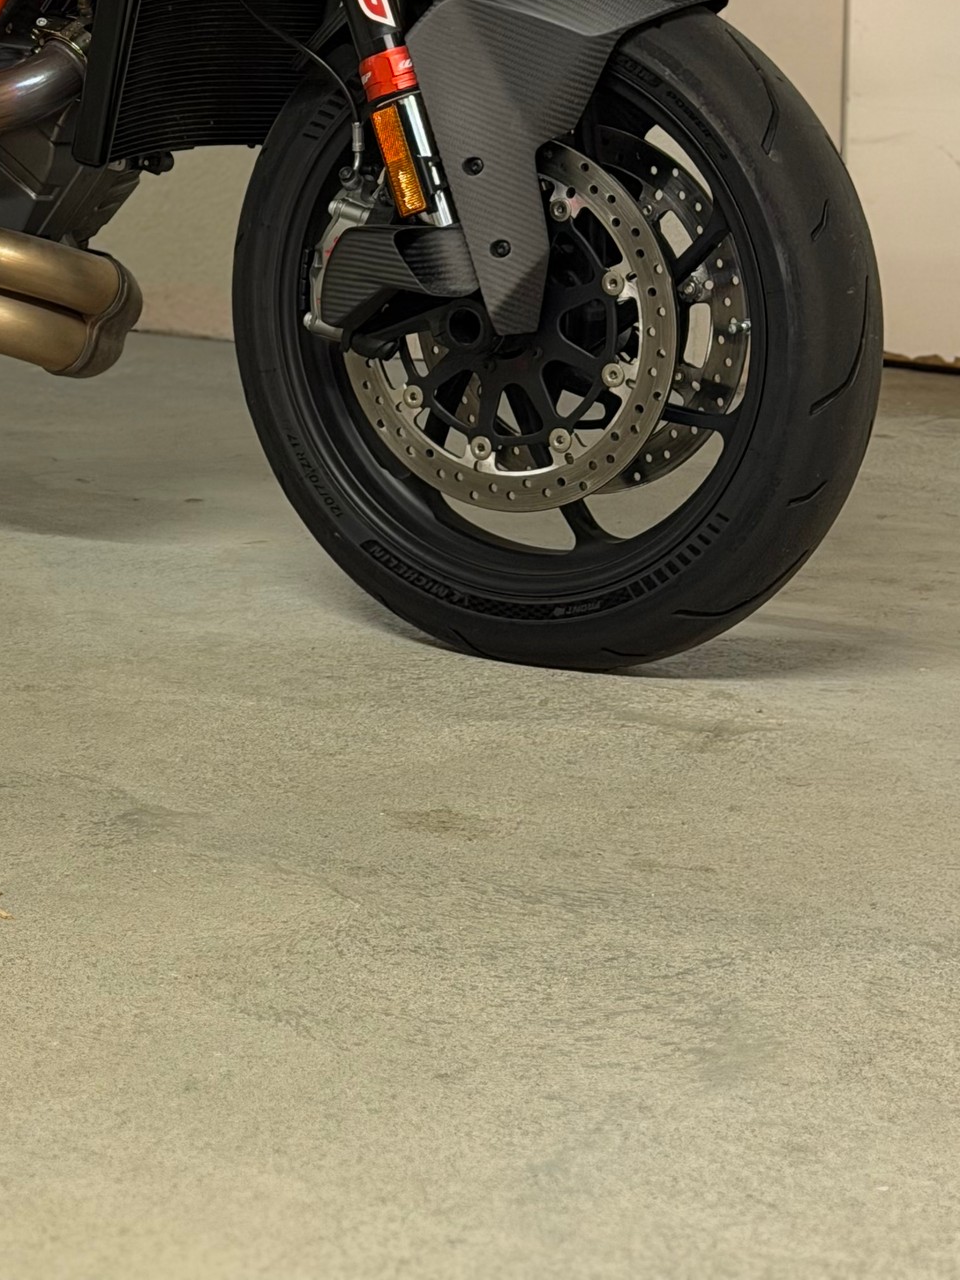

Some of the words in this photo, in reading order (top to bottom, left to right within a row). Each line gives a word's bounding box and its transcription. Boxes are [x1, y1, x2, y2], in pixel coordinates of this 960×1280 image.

[287, 434, 300, 448] 17
[309, 474, 344, 517] 120/70
[369, 544, 449, 598] MICHELIN
